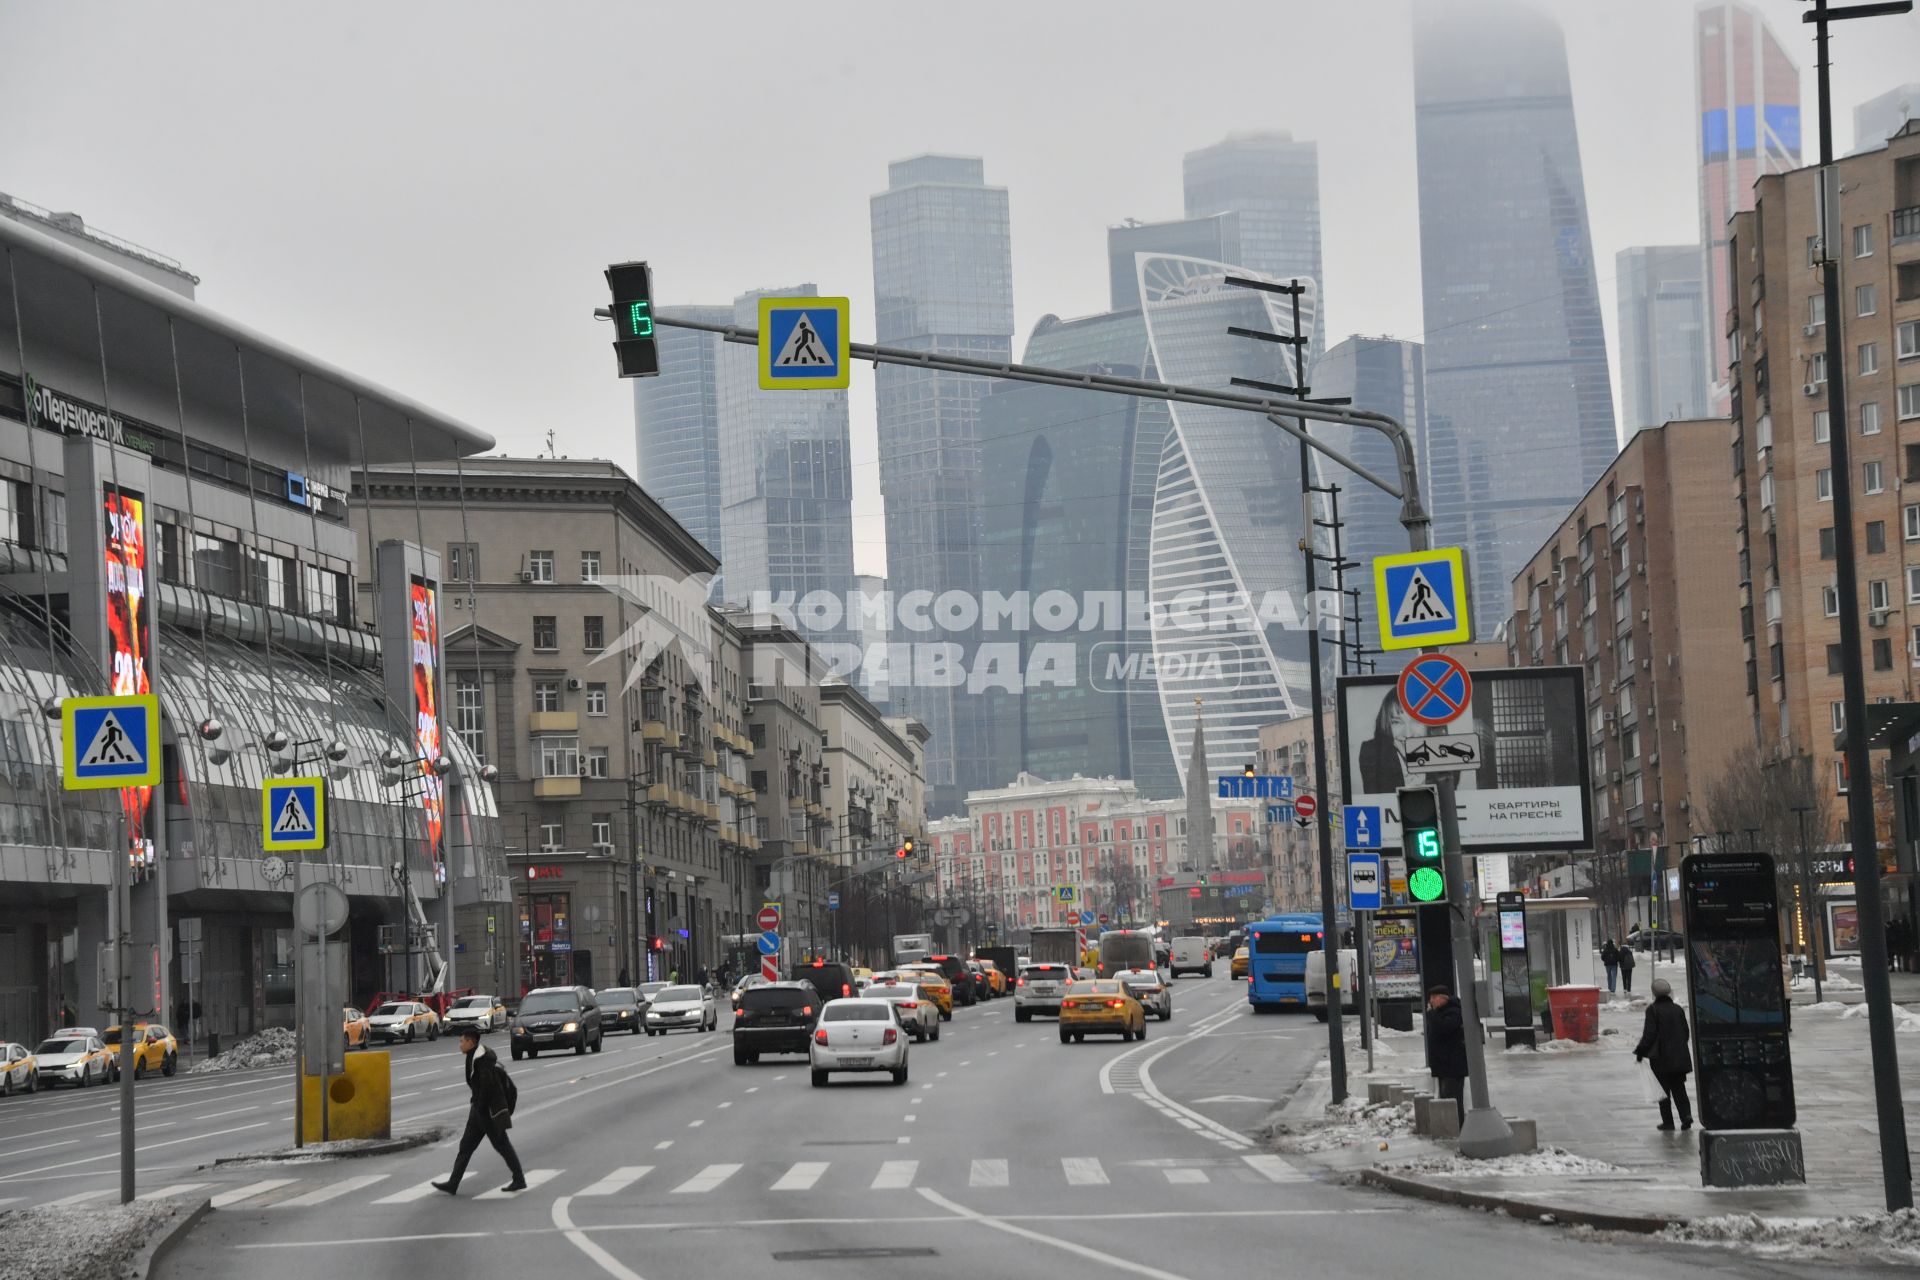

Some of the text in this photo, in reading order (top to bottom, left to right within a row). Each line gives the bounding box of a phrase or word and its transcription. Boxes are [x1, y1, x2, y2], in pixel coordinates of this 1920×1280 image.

[631, 302, 652, 335] 15
[1488, 800, 1561, 810] КВАРТИРЫ
[1489, 810, 1563, 820] НА ПРЕСНЕ
[1418, 831, 1438, 857] 15
[540, 866, 564, 879] МТС
